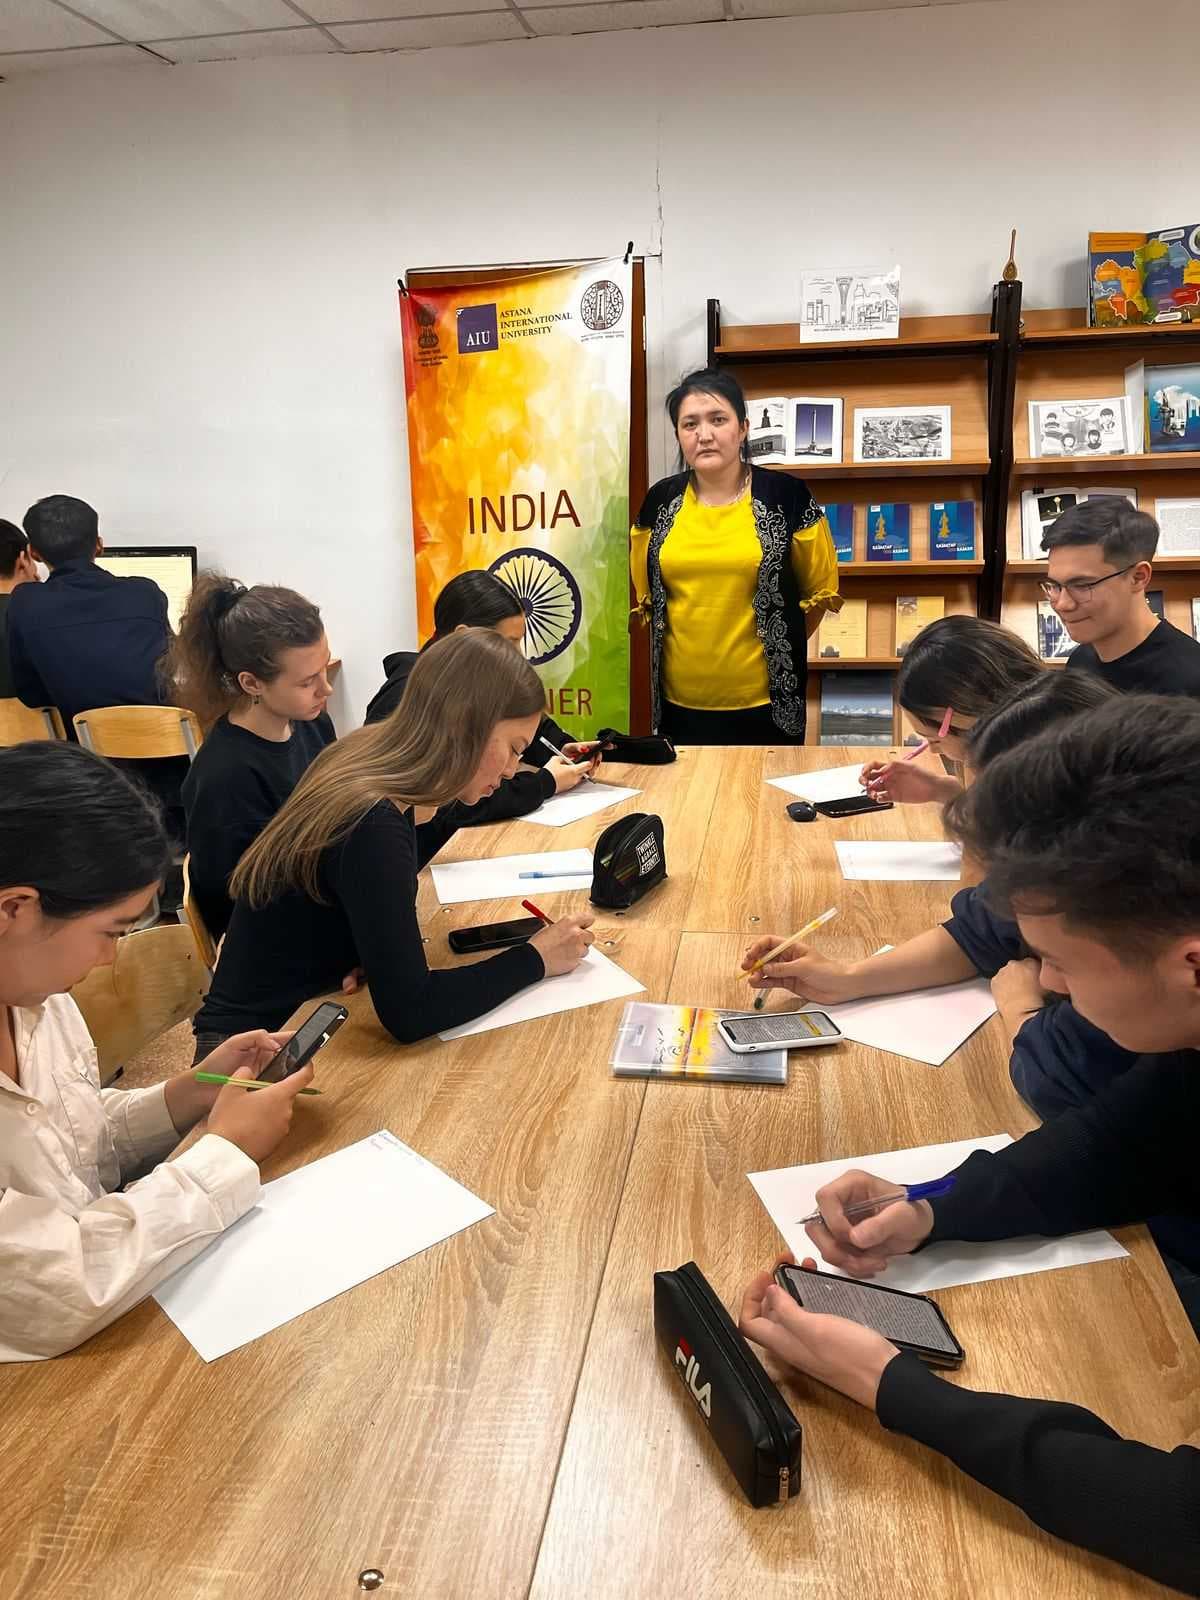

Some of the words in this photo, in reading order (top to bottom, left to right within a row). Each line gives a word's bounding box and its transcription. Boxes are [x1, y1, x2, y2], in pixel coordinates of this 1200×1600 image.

[500, 307, 532, 319] ASTANA
[500, 312, 573, 329] INTERNATIONAL
[466, 331, 490, 346] AIU
[501, 326, 552, 340] UNIVERSITY
[468, 489, 582, 534] INDIA
[675, 1338, 711, 1418] FILA
